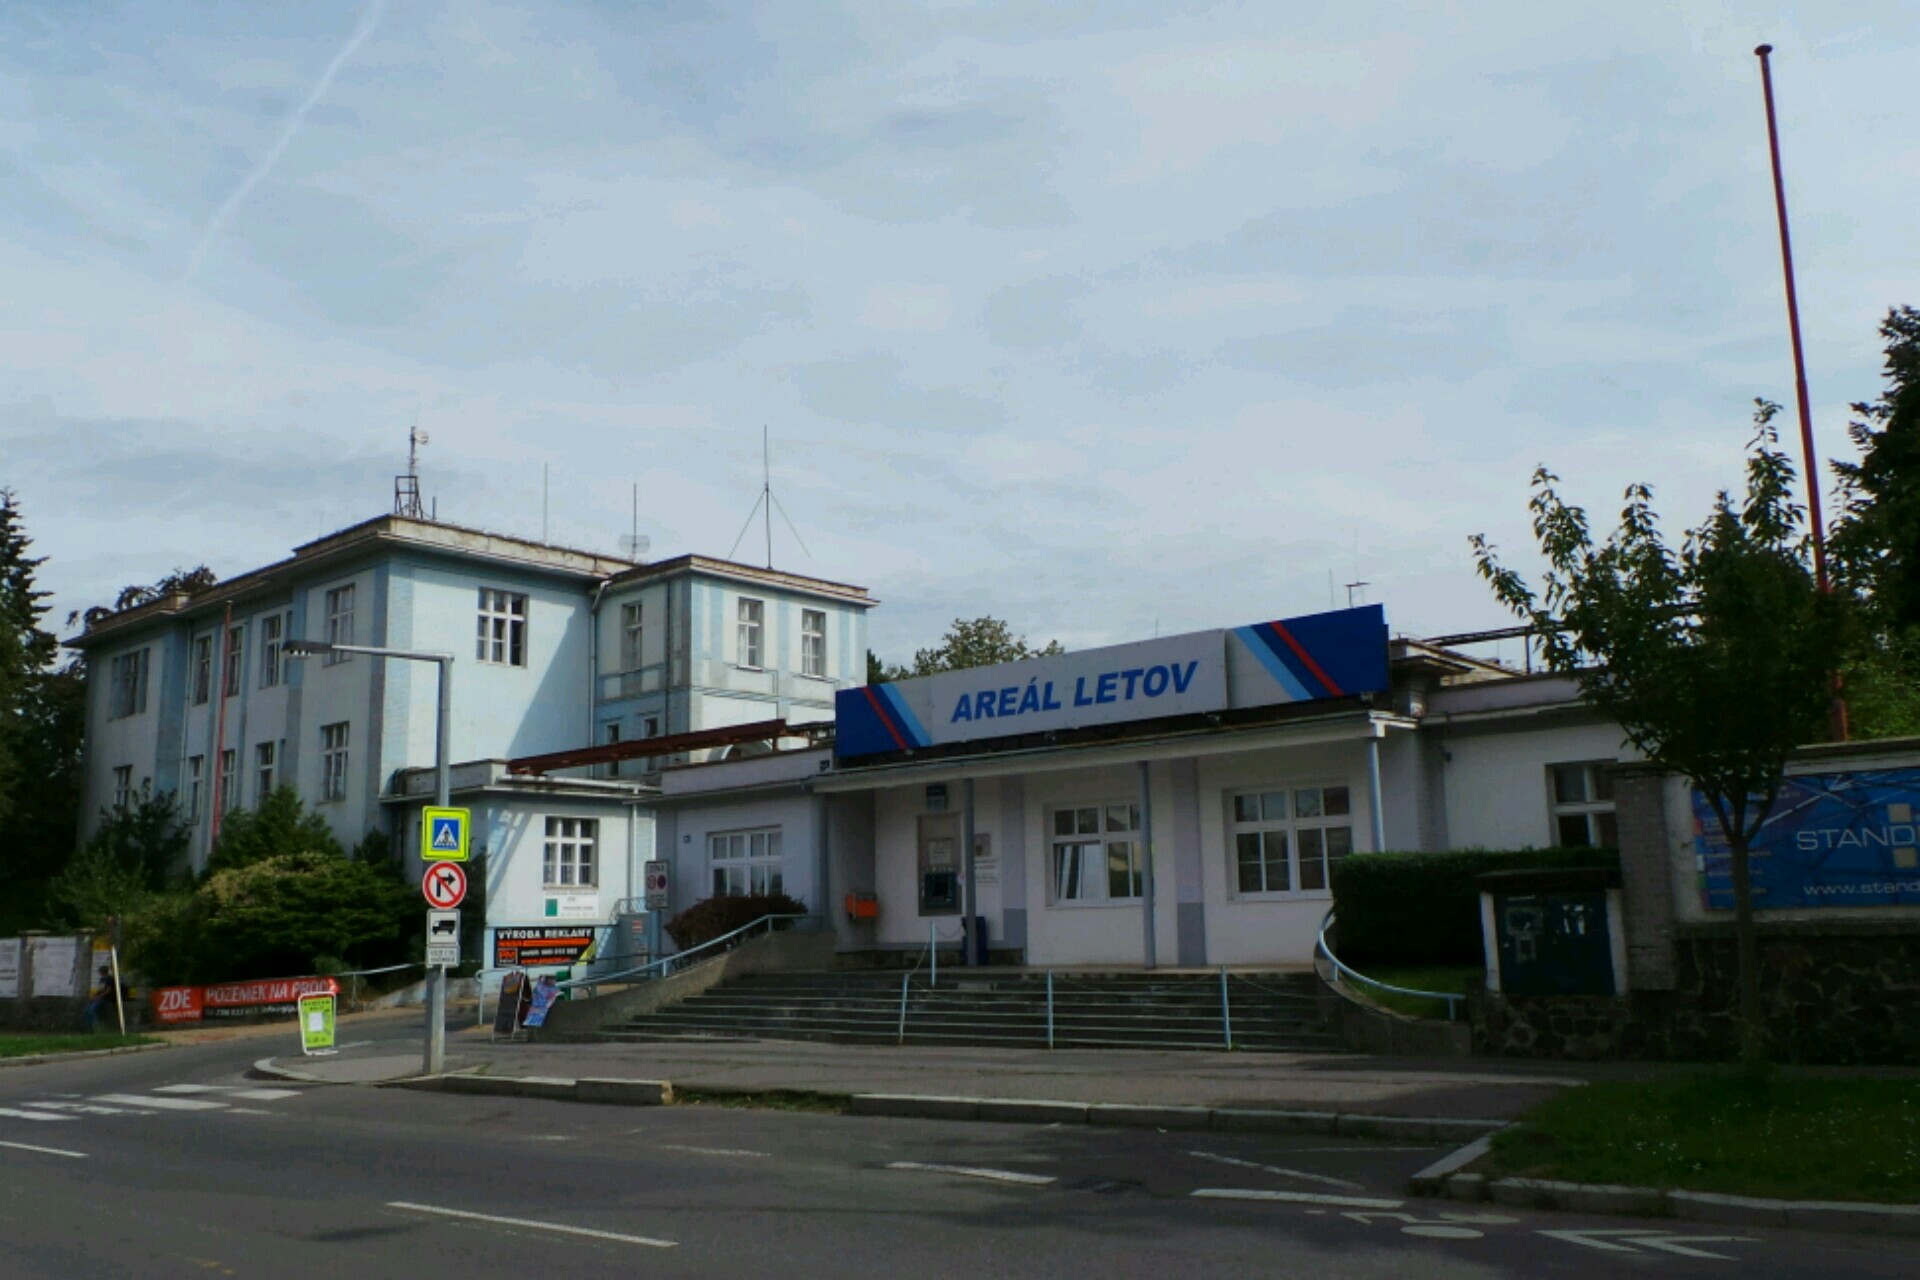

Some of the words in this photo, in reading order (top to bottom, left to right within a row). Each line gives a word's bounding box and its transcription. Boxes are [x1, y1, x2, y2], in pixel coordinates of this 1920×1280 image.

[951, 676, 1061, 723] AREÁL
[1074, 660, 1199, 707] LETOV
[497, 928, 541, 939] VÝROBA
[544, 927, 592, 938] REKLAMY
[159, 989, 193, 1010] ZDE
